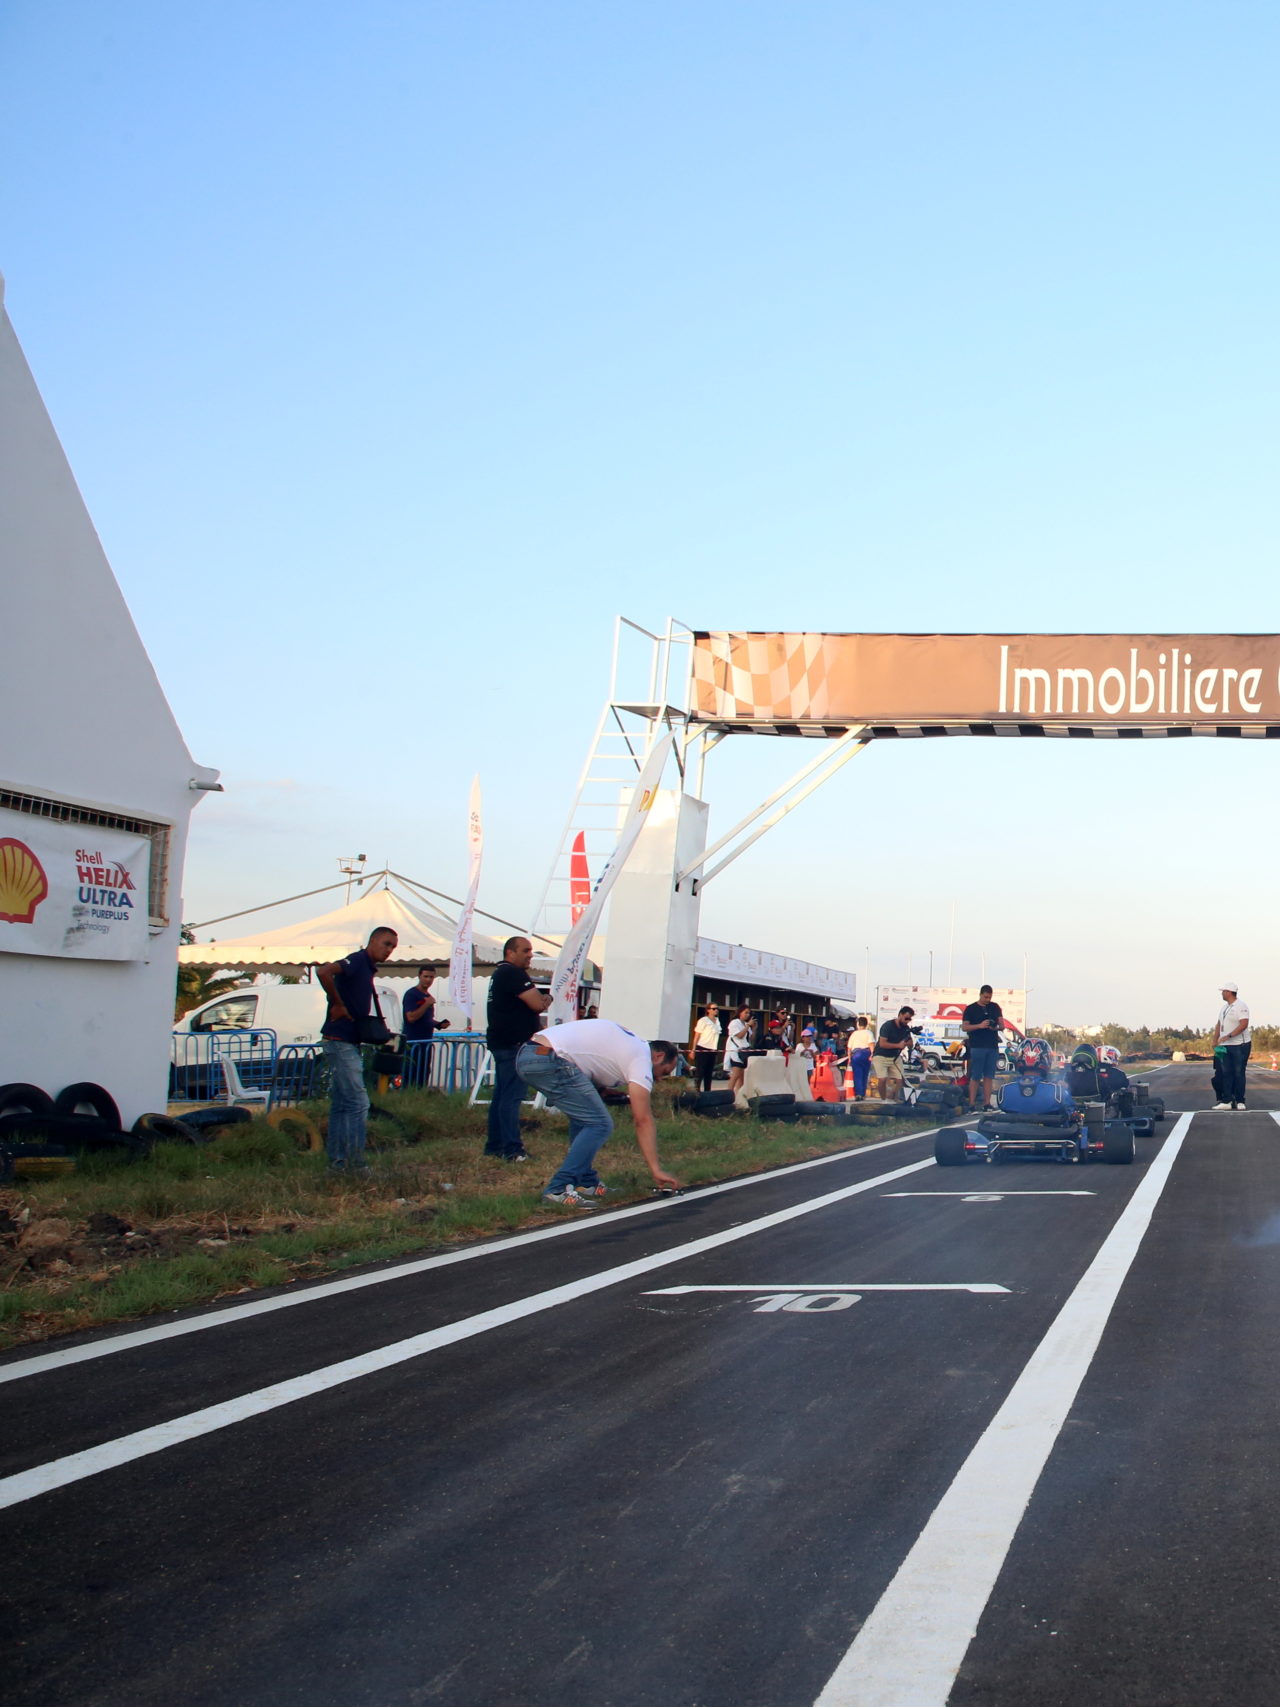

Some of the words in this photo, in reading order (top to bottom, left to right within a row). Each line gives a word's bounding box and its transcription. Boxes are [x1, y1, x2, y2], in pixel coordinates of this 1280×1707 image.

[998, 644, 1263, 714] Immobiliere
[75, 848, 103, 865] Shell
[77, 865, 136, 890] HELIX
[78, 886, 134, 908] ULTRA
[92, 909, 129, 920] PUREPLUS
[748, 1293, 862, 1313] 10
